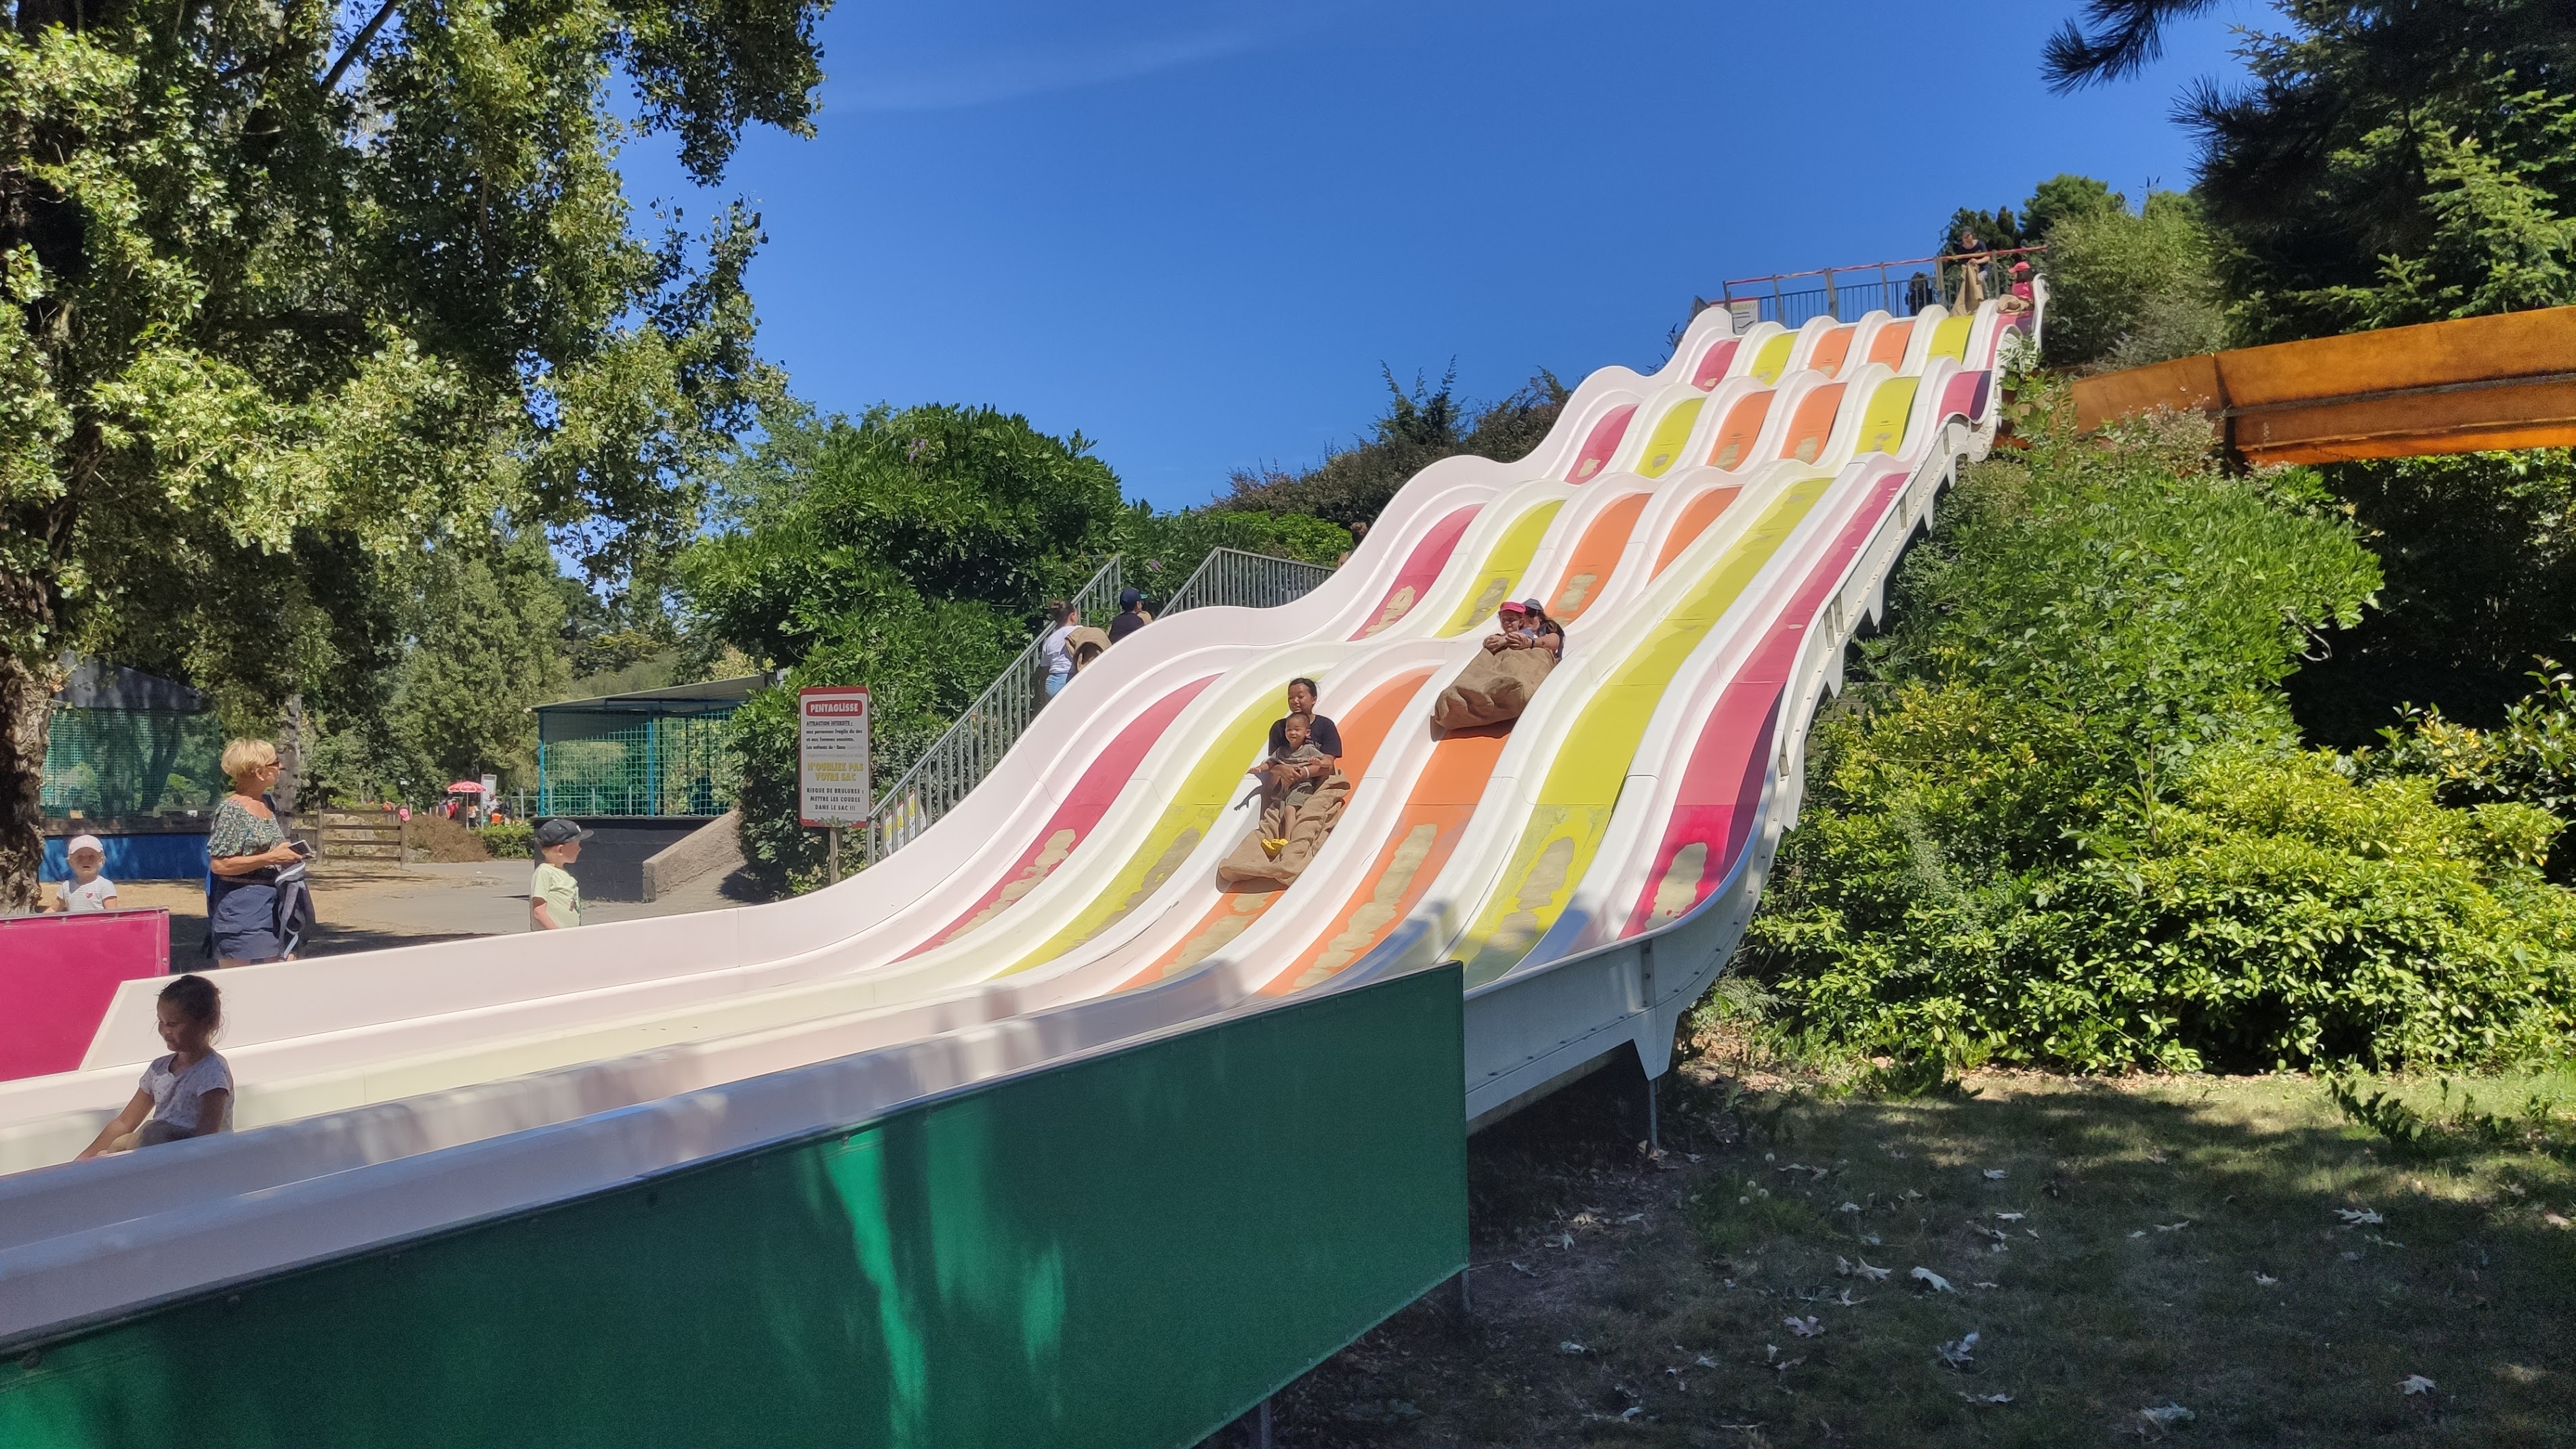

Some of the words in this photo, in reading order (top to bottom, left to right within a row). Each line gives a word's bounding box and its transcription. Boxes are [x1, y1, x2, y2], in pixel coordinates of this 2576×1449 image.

[807, 762, 846, 771] N'OUBLIEZ
[849, 762, 864, 771] PAS
[816, 773, 839, 781] VOTRE
[841, 773, 856, 781] SAC
